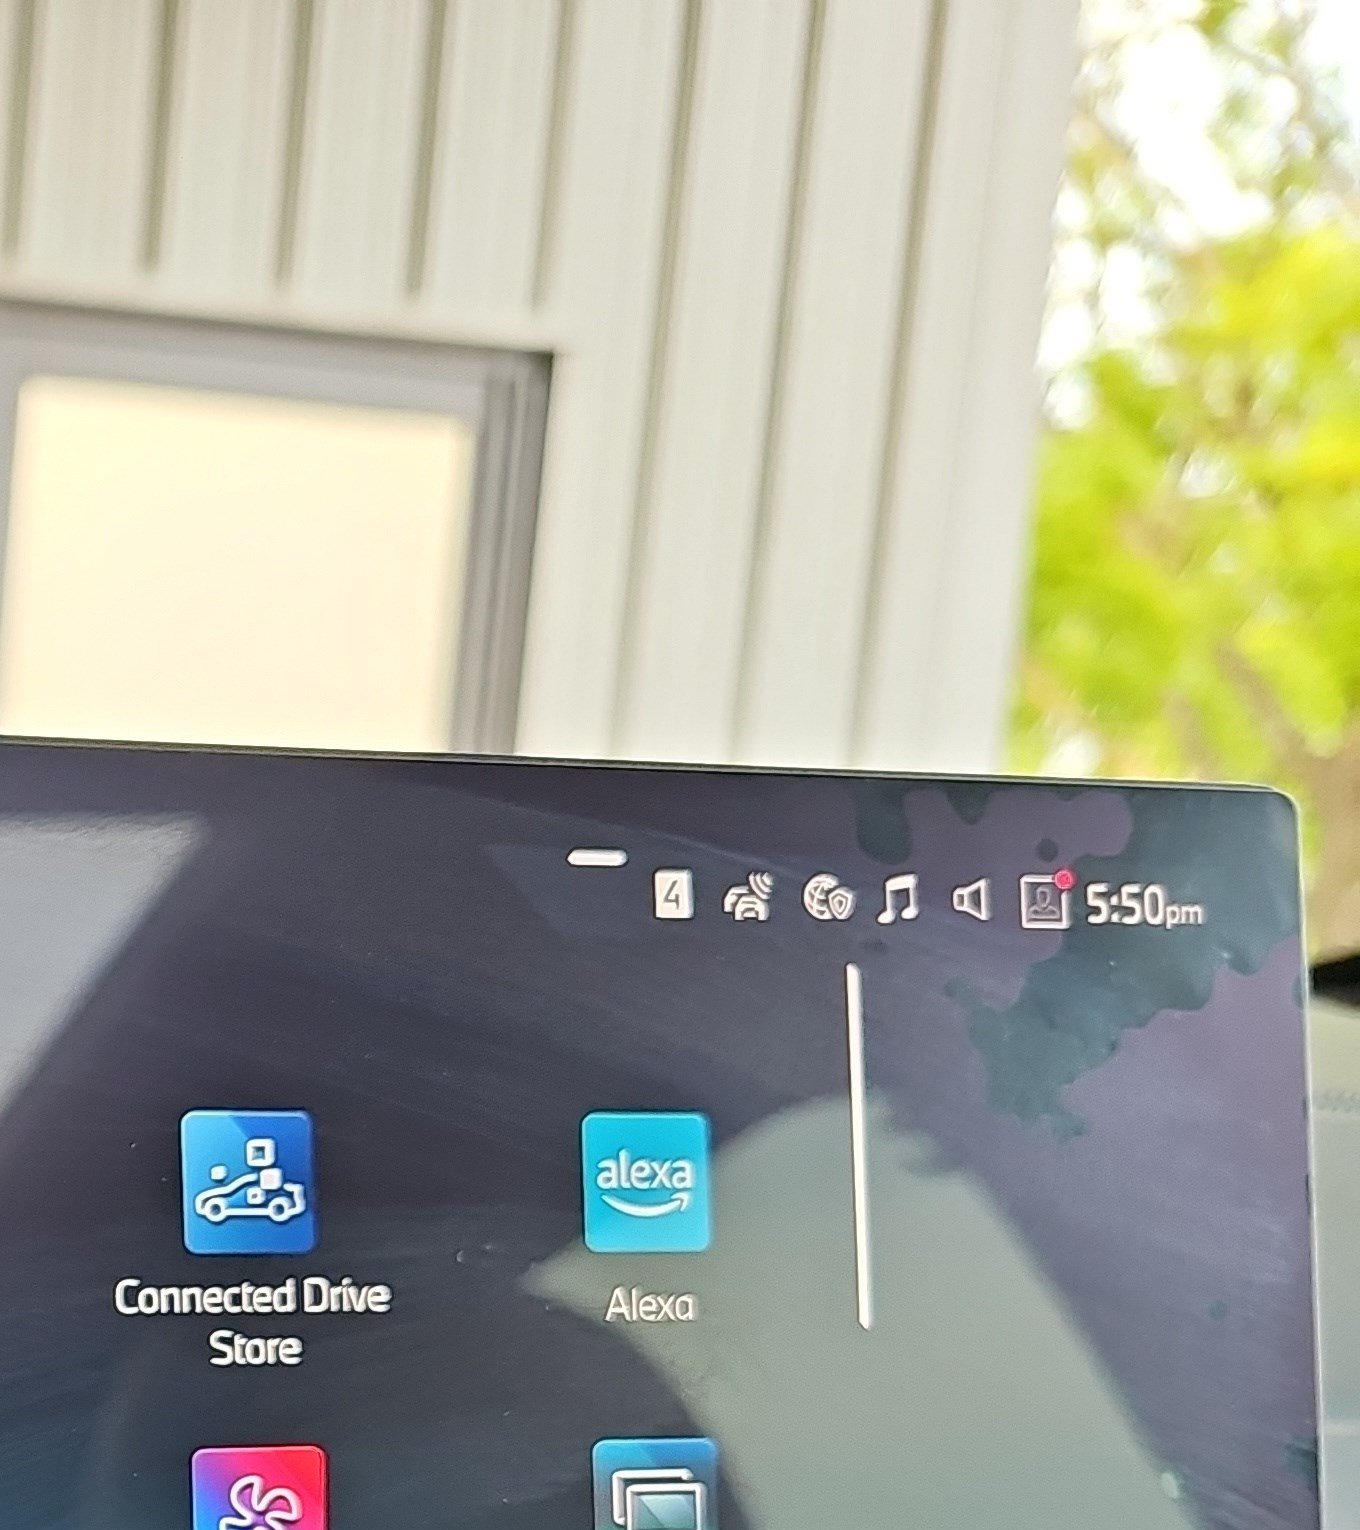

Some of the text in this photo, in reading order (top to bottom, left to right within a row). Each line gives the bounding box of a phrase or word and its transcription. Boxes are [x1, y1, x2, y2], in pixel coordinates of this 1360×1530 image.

[596, 1151, 696, 1192] alexa
[114, 1278, 392, 1316] Connected Drive
[604, 1287, 696, 1323] Alexa
[209, 1330, 303, 1367] Store
